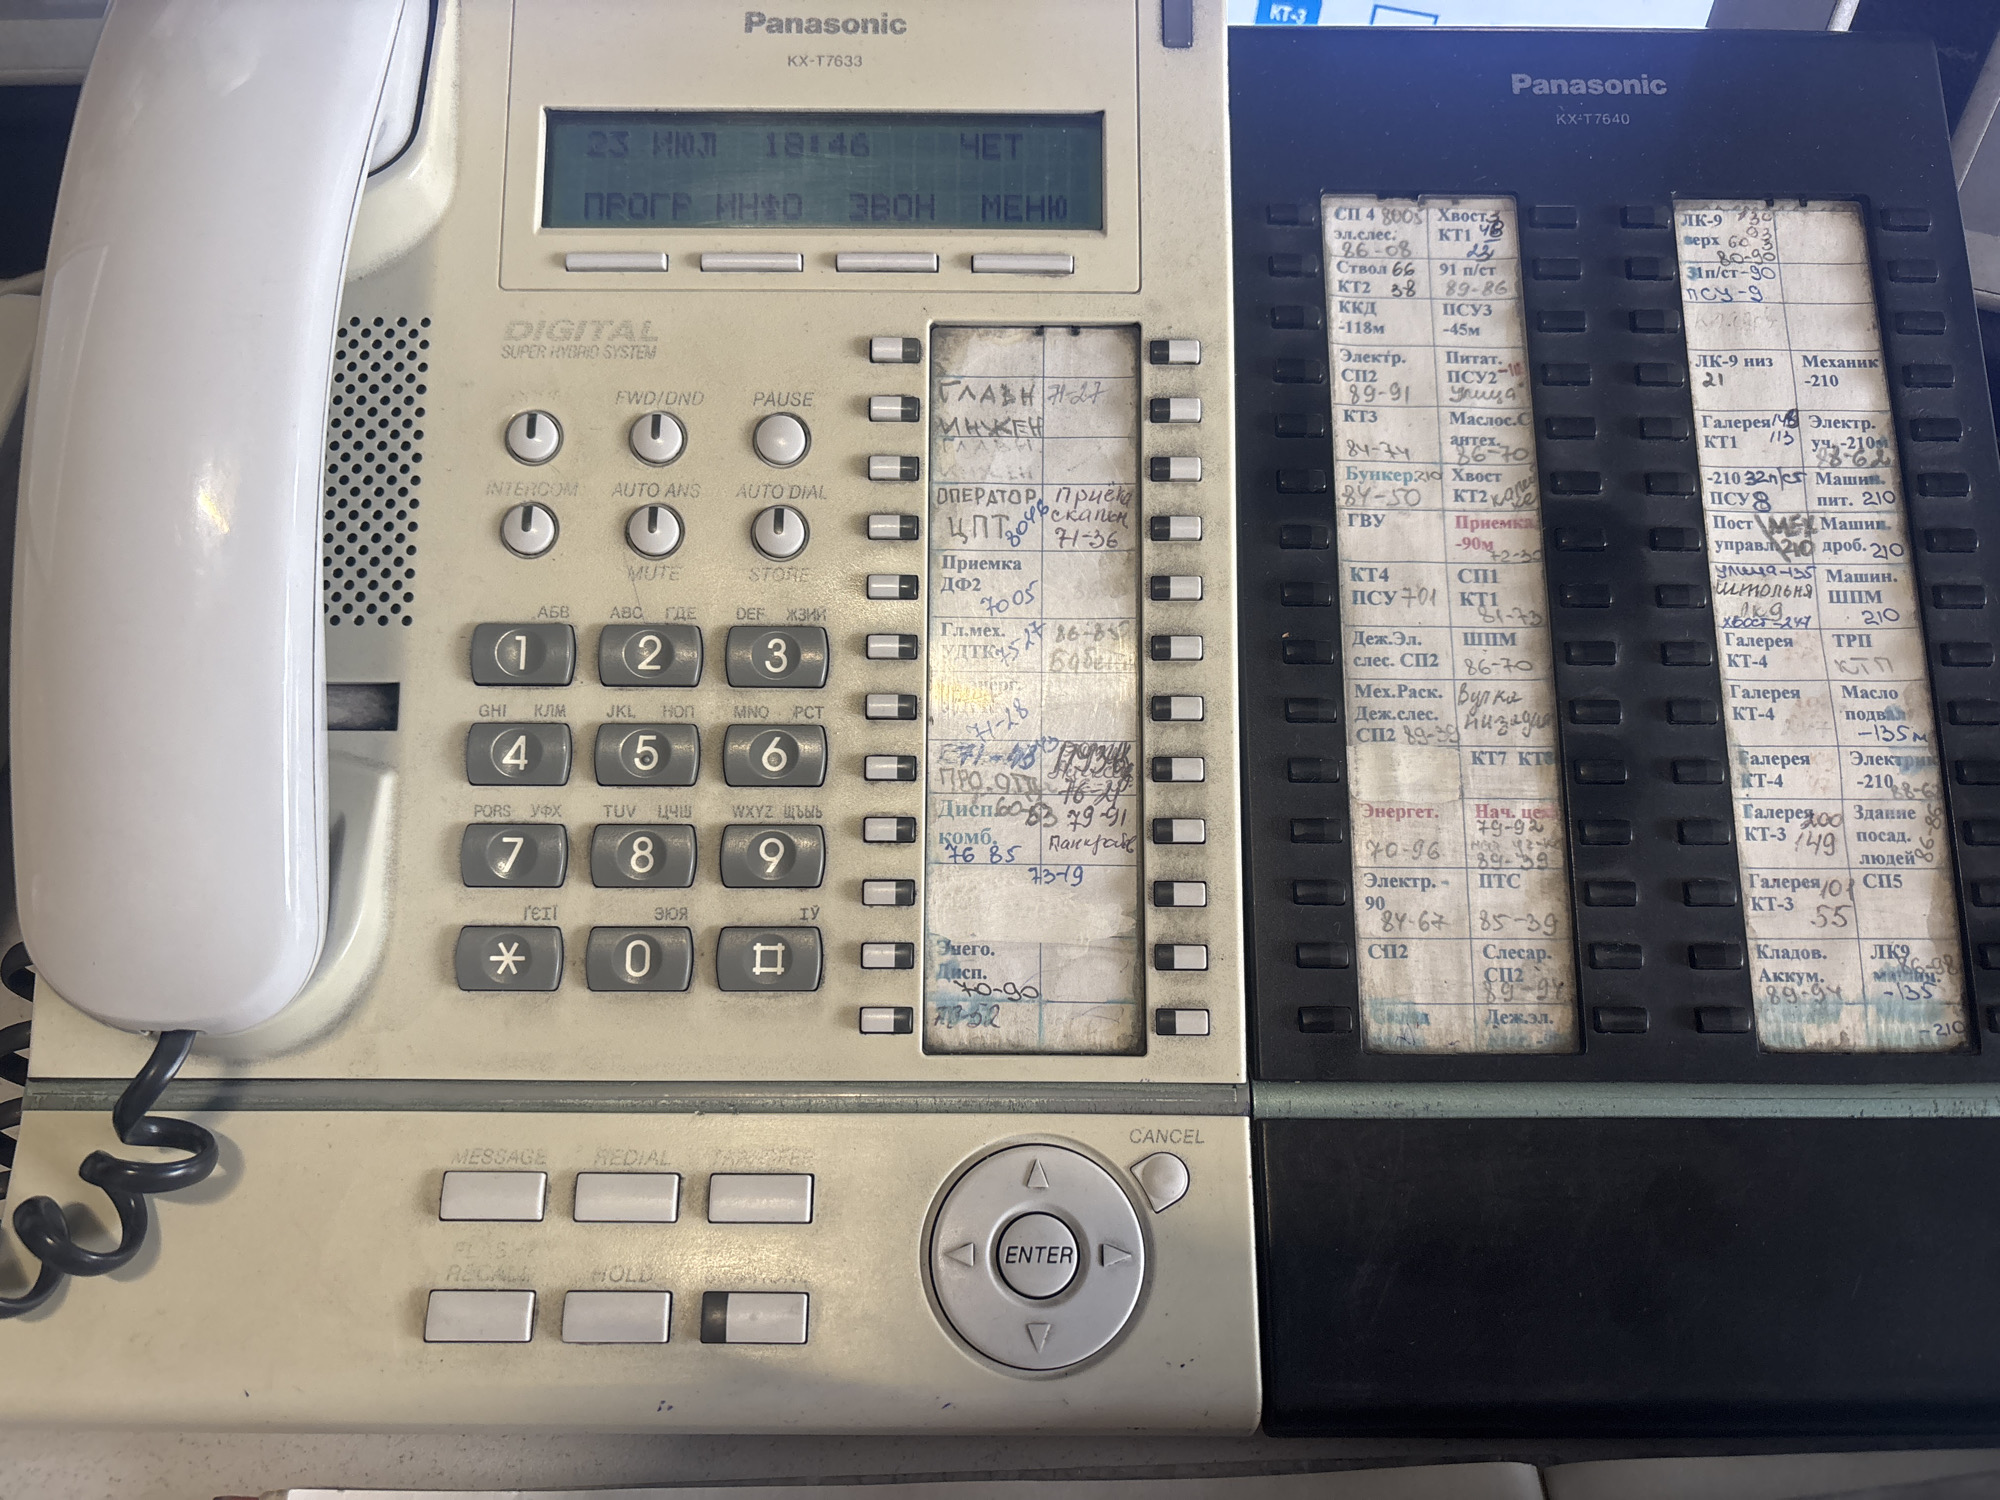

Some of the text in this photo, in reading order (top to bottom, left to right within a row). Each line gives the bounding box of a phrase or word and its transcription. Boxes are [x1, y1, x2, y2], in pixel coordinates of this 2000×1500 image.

[744, 12, 907, 36] Panasonic
[787, 55, 862, 68] KX-T7633
[1511, 73, 1668, 95] Panasonic
[1556, 113, 1630, 125] KX-T7640
[587, 131, 1023, 160] 23 ИЮЛ 18:46 ЧЕТ
[584, 193, 1067, 222] ПРОГР ИНФО ЗВОН МЕНЮ
[1334, 208, 1360, 221] СП
[1681, 214, 1722, 226] ЛК-9
[1438, 229, 1471, 241] КТ1
[1337, 261, 1387, 274] Ствол
[1439, 264, 1496, 276] 91 п/ст
[1338, 281, 1371, 294] КТ2
[1339, 301, 1377, 316] ККД
[503, 320, 658, 342] DIGITAL
[1443, 324, 1480, 336] -45м
[501, 345, 657, 359] SUPER HYBRID SYSTEM
[1340, 349, 1406, 365] Электр.
[1446, 352, 1502, 365] Питат.
[1695, 355, 1773, 367] ЛК-9 низ
[1802, 356, 1879, 368] Механик
[1341, 369, 1377, 382] СП2
[1447, 371, 1498, 384] ПСУ2
[1805, 375, 1839, 387] -210
[616, 391, 704, 406] FWD/DND
[753, 392, 814, 407] PAUSE
[1343, 410, 1378, 422] КТ3
[1701, 415, 1771, 431] Галерея
[1809, 416, 1876, 432] Электр.
[1450, 436, 1501, 446] антех.
[1704, 436, 1738, 448] КТ1
[1346, 466, 1418, 486] Бункер.
[1452, 468, 1502, 482] Хвост
[1707, 472, 1740, 485] -210
[486, 482, 579, 497] INTERCOM
[612, 483, 701, 498] AUTO ANS
[736, 484, 828, 499] AUTO DIAL
[1453, 489, 1487, 503] КТ2
[937, 488, 1037, 506] ОПЕРАТОР
[1710, 492, 1750, 506] ПСУ
[1817, 497, 1853, 506] пит.
[1347, 514, 1385, 527] ГВУ
[1455, 516, 1535, 533] Приемка
[1713, 516, 1753, 530] Пост
[1455, 538, 1494, 550] -90м
[1823, 539, 1866, 553] дроб.
[941, 555, 1022, 572] Приемка
[627, 566, 682, 581] MUTE
[748, 567, 811, 582] STORE
[1350, 567, 1389, 582] КТ4
[1457, 569, 1499, 584] СП1
[1826, 569, 1897, 583] Машин.
[940, 578, 981, 593] ДФ2
[1352, 591, 1397, 605] ПСУ
[1460, 592, 1498, 606] КТ1
[1828, 590, 1883, 603] ШПМ
[537, 606, 570, 620] АБВ
[610, 606, 641, 620] ABC
[665, 606, 697, 621] ГДЕ
[736, 608, 765, 620] DEF
[786, 607, 826, 621] ЖЗИЙ
[941, 623, 1005, 638] Гл.мех.
[1352, 631, 1422, 647] Деж.Эл.
[1463, 632, 1517, 646] ШПМ
[1724, 632, 1794, 651] Галерея
[1832, 634, 1872, 648] ТРП
[515, 636, 526, 670] 1
[638, 635, 661, 670] 2
[765, 639, 787, 673] 3
[1353, 653, 1439, 667] слес. СП2
[1727, 654, 1768, 668] КТ-4
[1354, 684, 1443, 699] Мех.Раск.
[1730, 685, 1801, 705] Галерея
[1842, 685, 1899, 699] Масло
[479, 705, 507, 718] GHI
[534, 705, 566, 718] КЛМ
[607, 705, 636, 719] JKL
[662, 705, 695, 719] НОП
[733, 706, 769, 719] MNO
[794, 706, 824, 719] РСТ
[1354, 707, 1439, 722] Деж.слес.
[1732, 707, 1775, 721] КТ-4
[1356, 728, 1396, 742] СП2
[502, 735, 528, 770] 4
[634, 735, 659, 770] 5
[762, 737, 787, 772] 6
[1471, 752, 1507, 765] КТ7
[1857, 775, 1893, 788] -210
[530, 805, 562, 818] УФХ
[603, 805, 636, 818] TUV
[658, 805, 692, 820] ЦЧШ
[732, 805, 773, 819] WXYZ
[784, 805, 823, 821] ЩЪЫЬ
[938, 800, 997, 819] Дисп.
[1362, 803, 1439, 822] Энергет.
[1476, 804, 1516, 818] Нач.
[1743, 804, 1814, 821] Галерея
[1853, 805, 1916, 821] Здание
[939, 827, 998, 845] комб.
[1745, 828, 1786, 841] КТ-3
[1857, 831, 1911, 843] посад.
[502, 837, 524, 873] 7
[630, 837, 654, 873] 8
[759, 838, 784, 873] 9
[1860, 853, 1915, 866] людей
[1479, 874, 1521, 889] ПТС
[1749, 874, 1821, 892] Галерея
[1863, 874, 1903, 889] СП5
[1365, 896, 1385, 910] 90
[1751, 897, 1794, 911] КТ-3
[655, 908, 688, 921] ЭЮЯ
[625, 940, 650, 977] 0
[1368, 944, 1408, 959] СП2
[1483, 944, 1551, 961] Слесар.
[1757, 945, 1827, 960] Кладов.
[1871, 945, 1910, 960] ЛК9
[1484, 968, 1524, 982] СП2
[1759, 969, 1824, 985] Аккум.
[1130, 1128, 1204, 1145] CANCEL
[451, 1150, 547, 1165] MESSAGE
[594, 1150, 672, 1166] REDIAL
[1004, 1245, 1073, 1266] ENTER
[593, 1266, 654, 1282] HOLD
